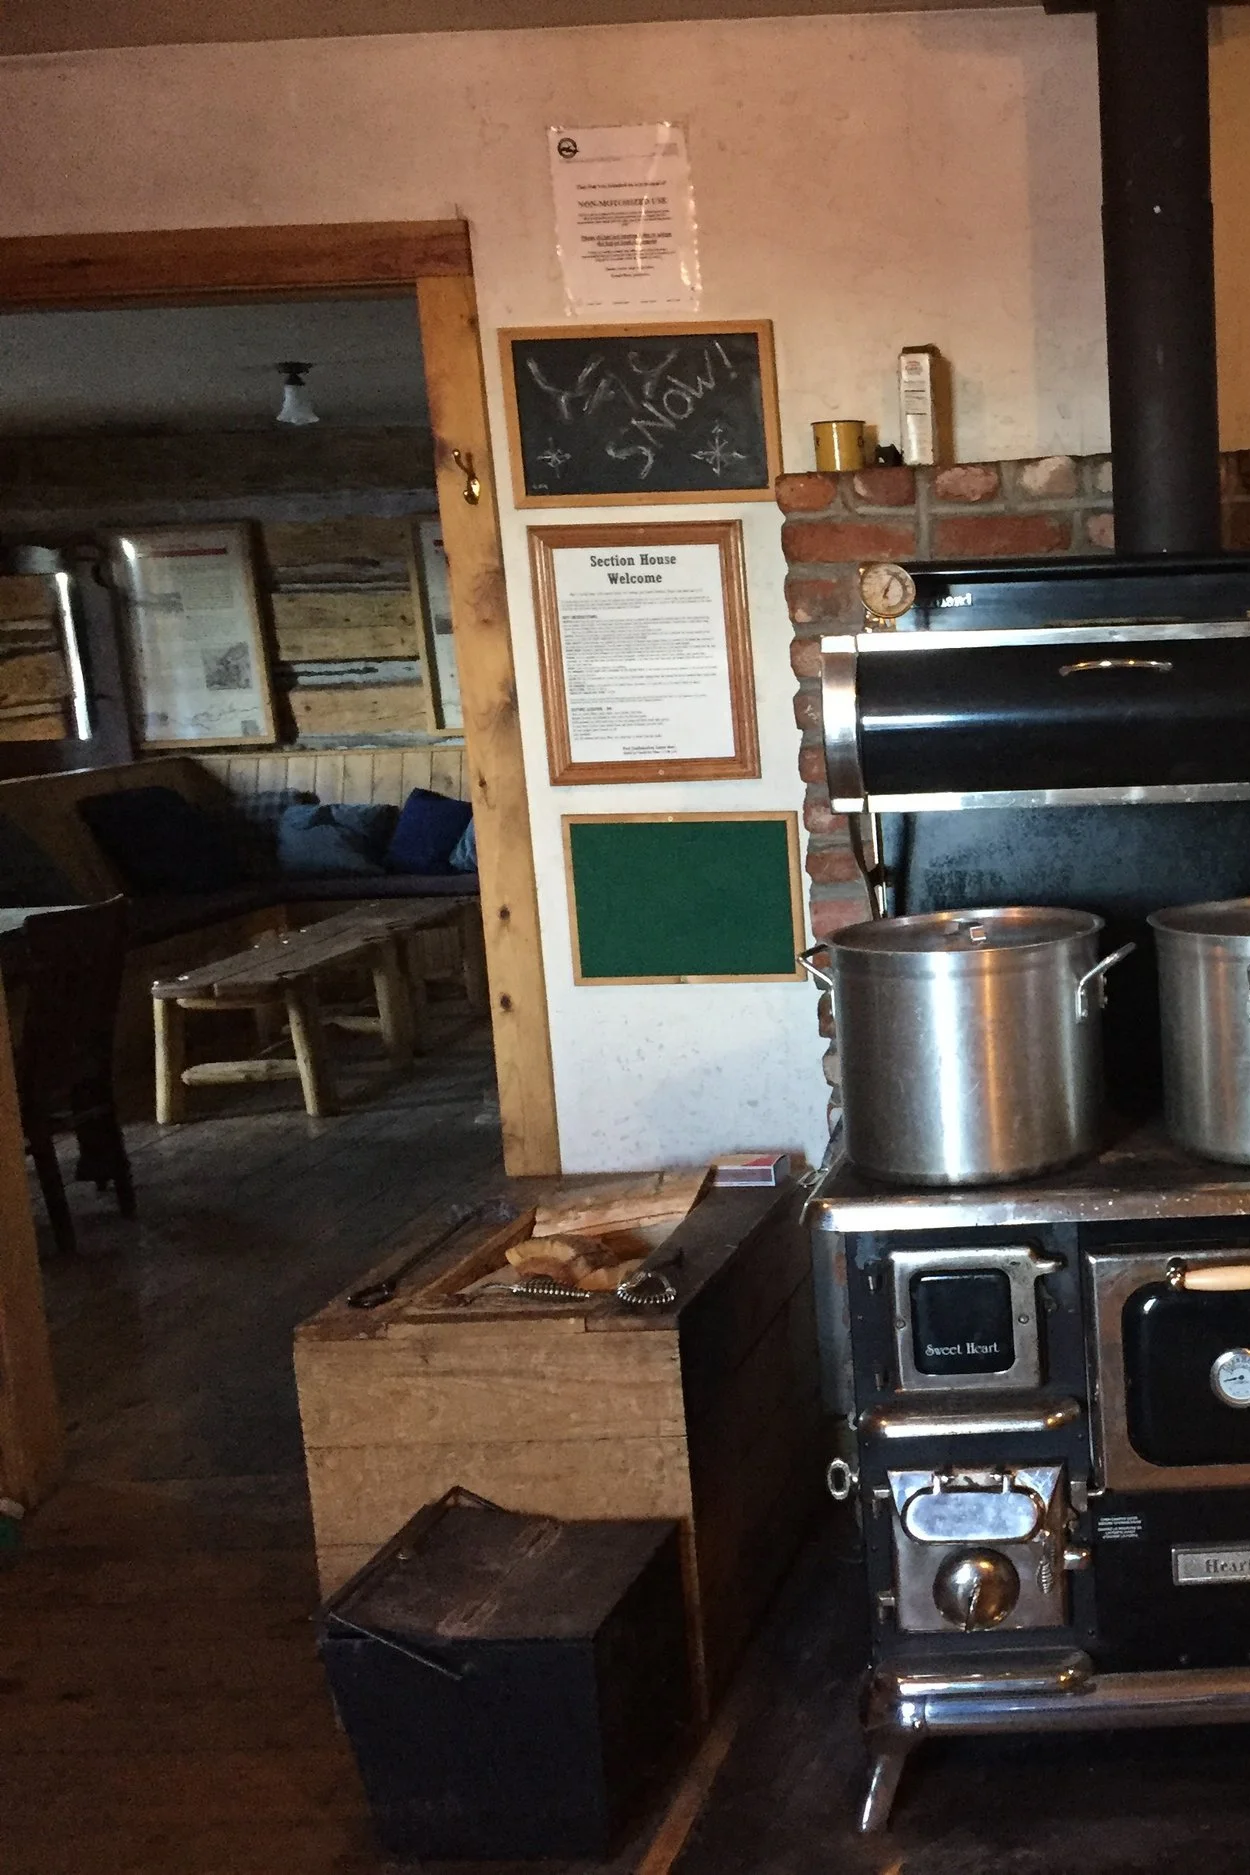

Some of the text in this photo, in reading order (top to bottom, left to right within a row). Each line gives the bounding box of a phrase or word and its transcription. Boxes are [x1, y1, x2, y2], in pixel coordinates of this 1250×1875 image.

[590, 553, 677, 567] Section House
[607, 572, 662, 585] Welcome
[925, 1342, 1001, 1357] Sweet Heart
